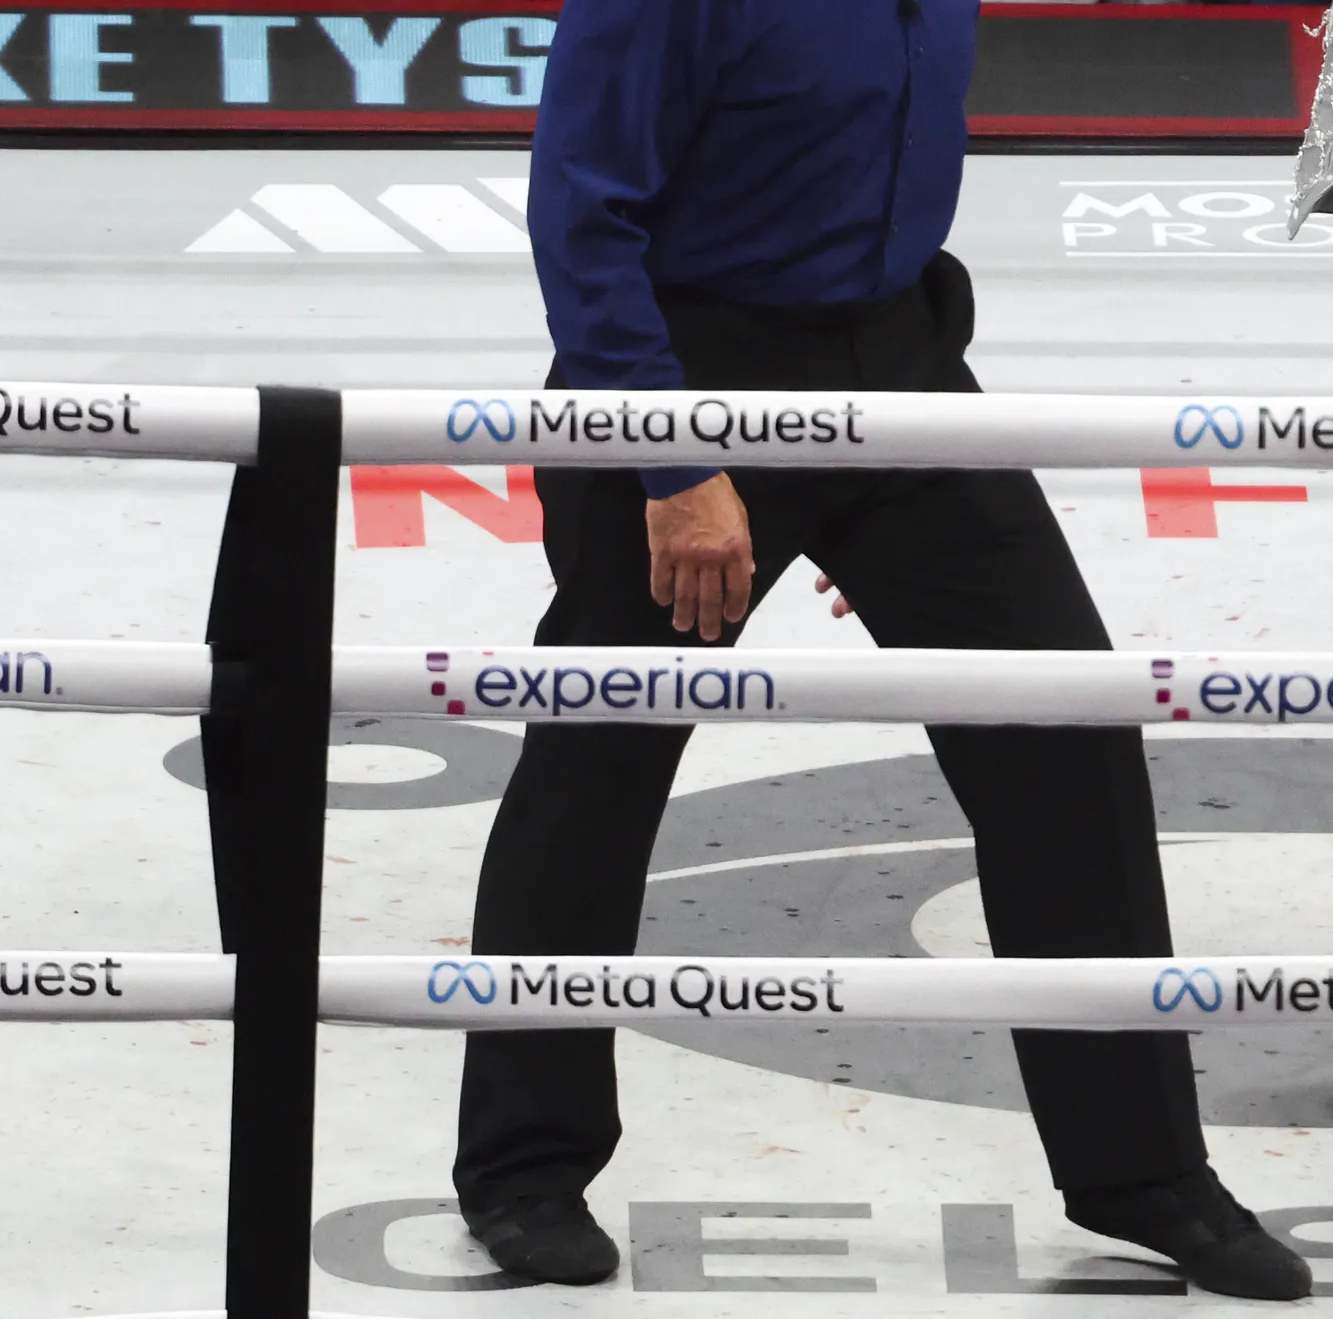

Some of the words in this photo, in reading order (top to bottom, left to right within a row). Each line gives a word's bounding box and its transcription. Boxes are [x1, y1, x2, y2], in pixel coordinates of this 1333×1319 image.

[189, 15, 560, 106] TYS
[530, 399, 675, 443] Meta
[689, 397, 864, 449] Quest
[474, 657, 774, 713] experian
[0, 957, 122, 997] uest
[511, 963, 655, 1008] Meta
[670, 963, 844, 1018] Quest
